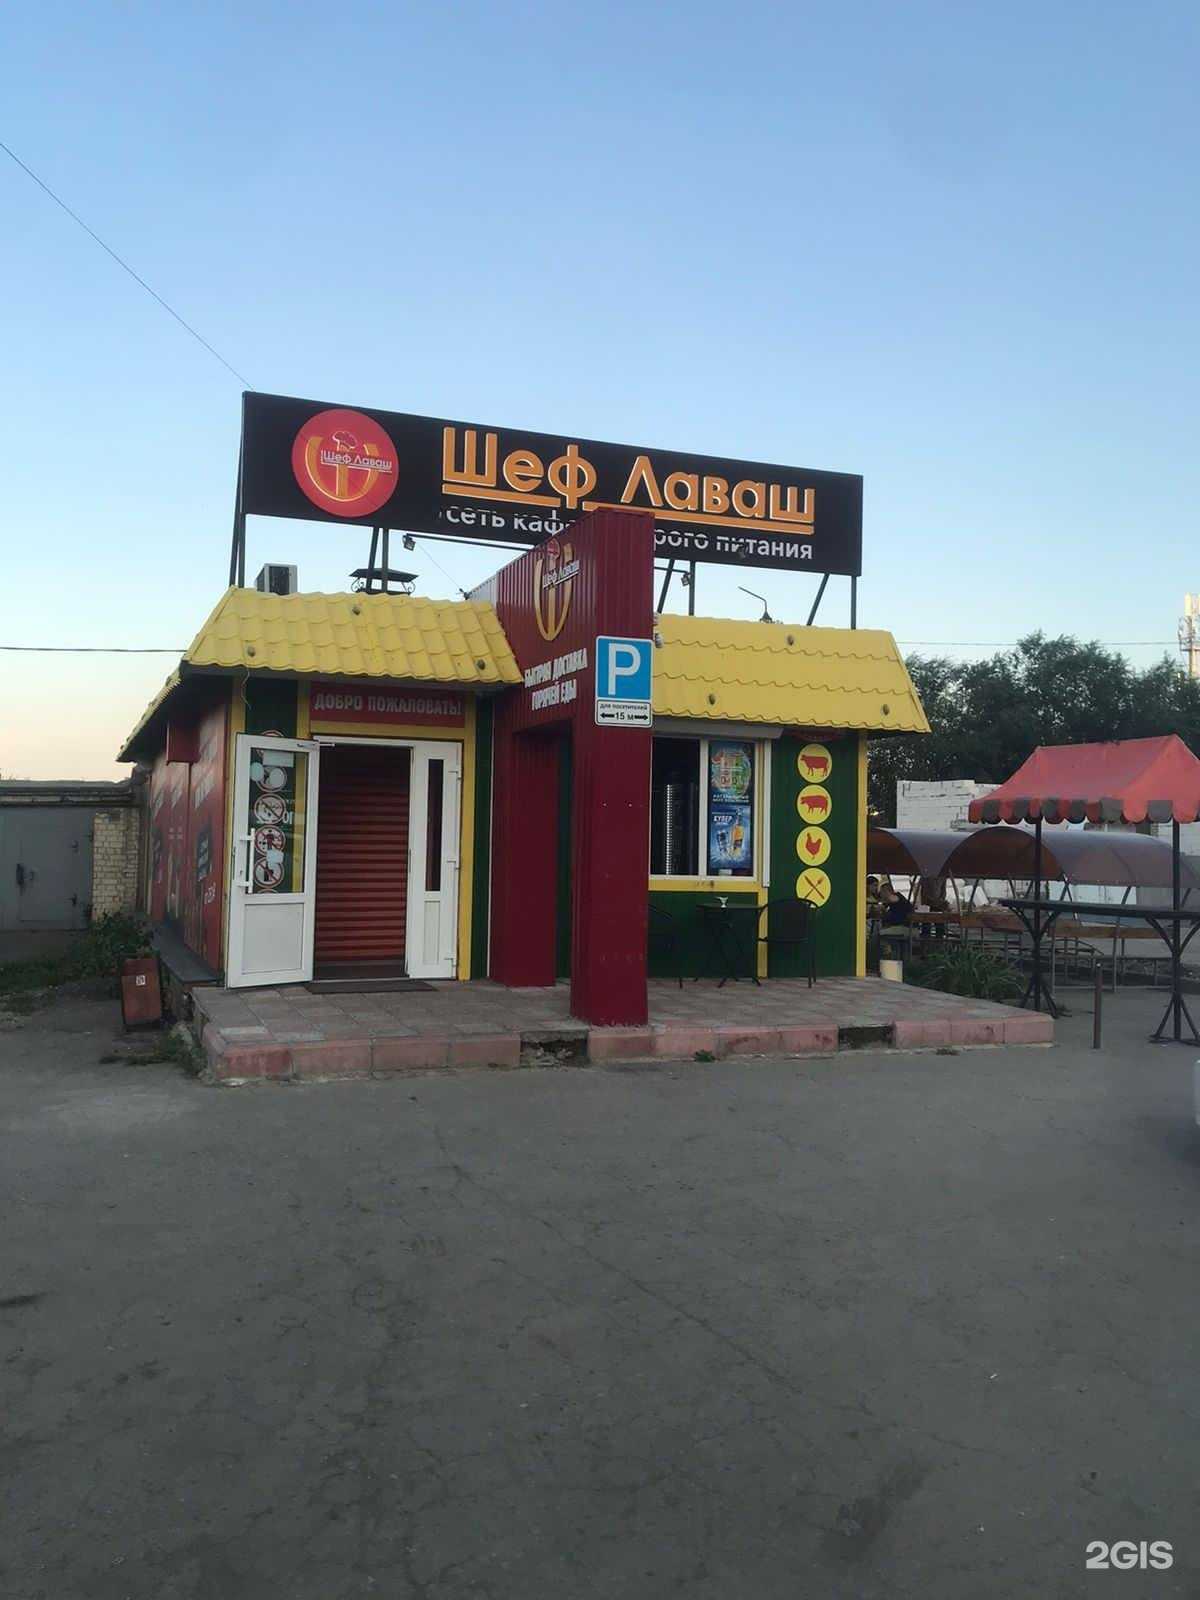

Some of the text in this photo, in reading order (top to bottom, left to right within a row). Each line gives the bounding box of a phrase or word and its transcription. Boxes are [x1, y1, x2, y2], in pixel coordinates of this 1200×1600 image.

[321, 449, 392, 470] Шеф Лаваш
[442, 427, 815, 523] Шеф Лаваш
[446, 506, 505, 528] сеть
[314, 694, 462, 715] ДОБРО ПОЖАЛОВАТЬ!
[616, 711, 625, 721] 15
